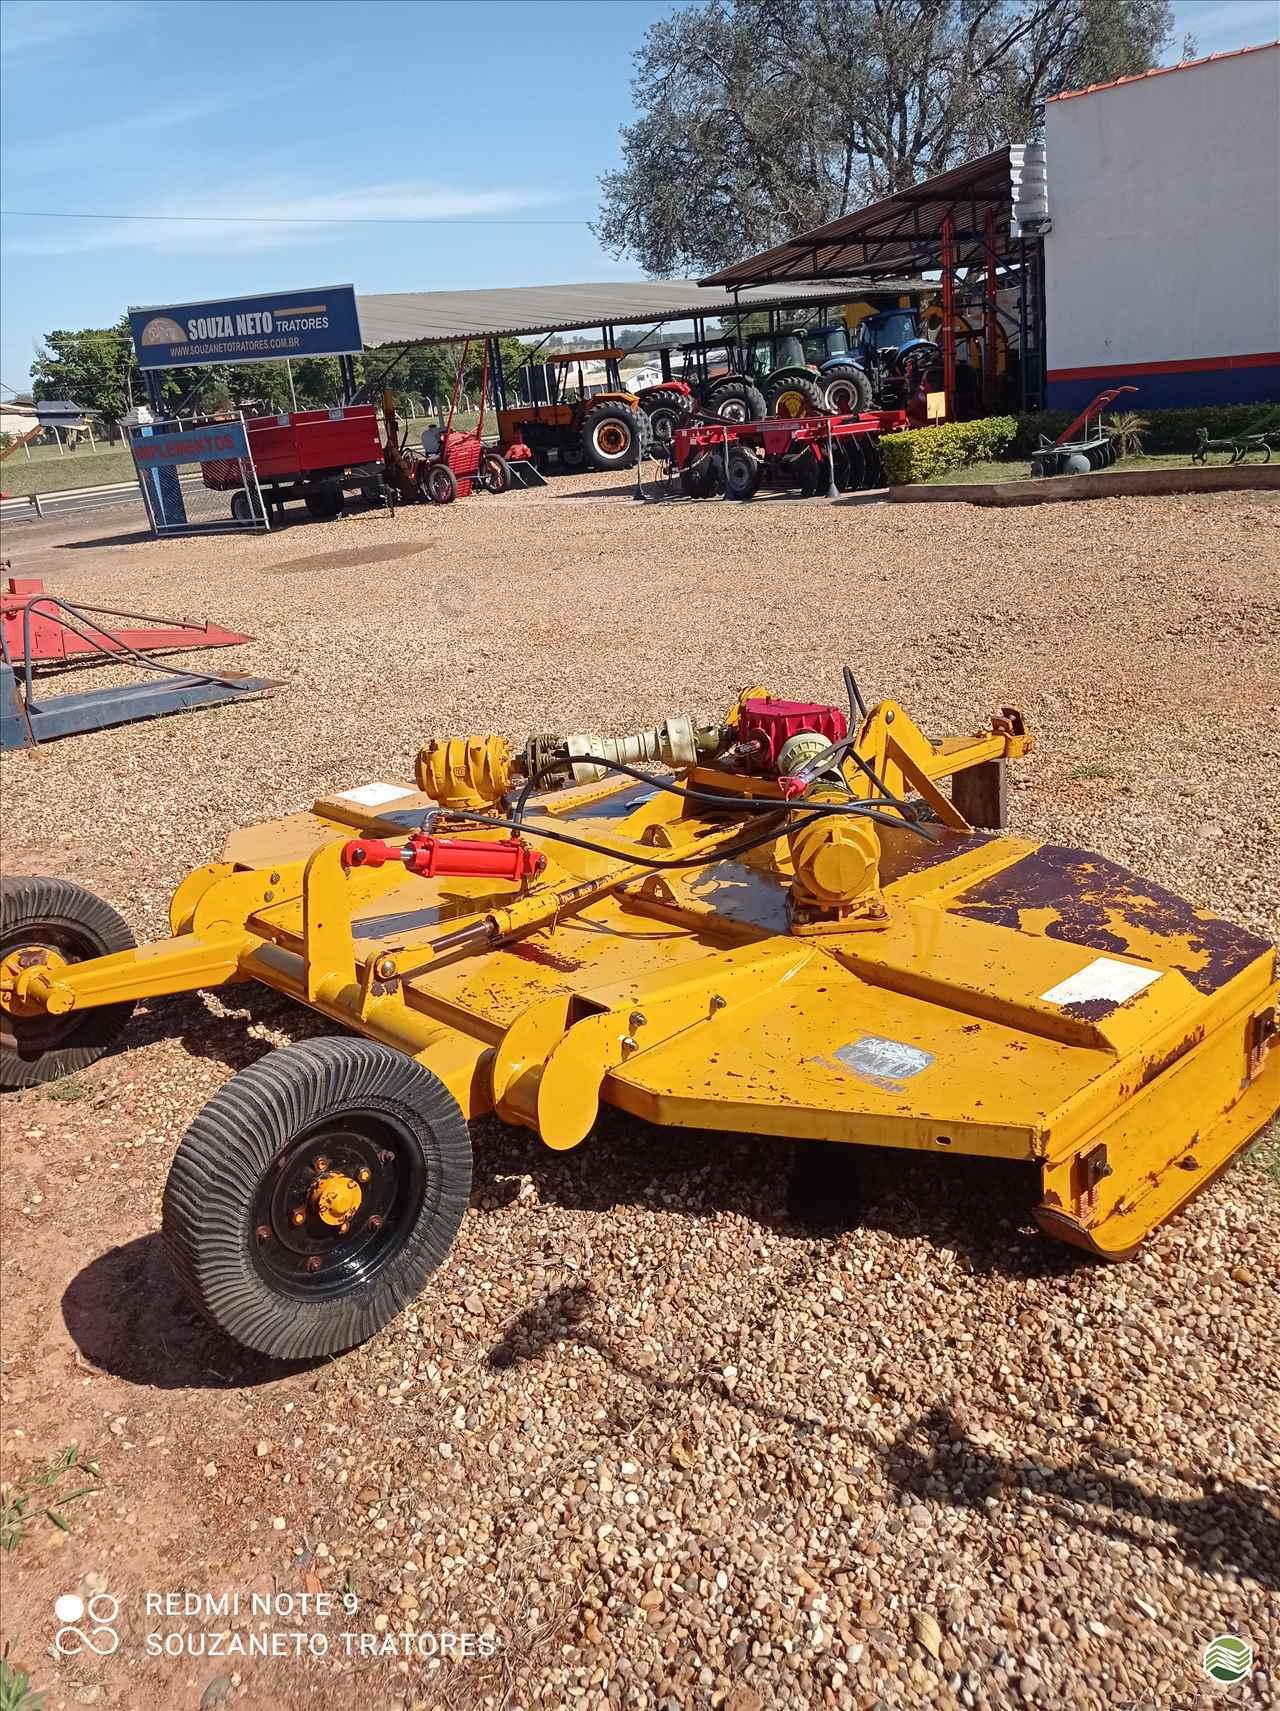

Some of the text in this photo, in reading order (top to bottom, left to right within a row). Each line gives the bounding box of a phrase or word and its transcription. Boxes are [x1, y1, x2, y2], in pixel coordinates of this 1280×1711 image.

[187, 311, 329, 341] SOUZA NETO TRATORES
[169, 336, 300, 357] WWW.SOUZANETOTRATORES.COM.BR
